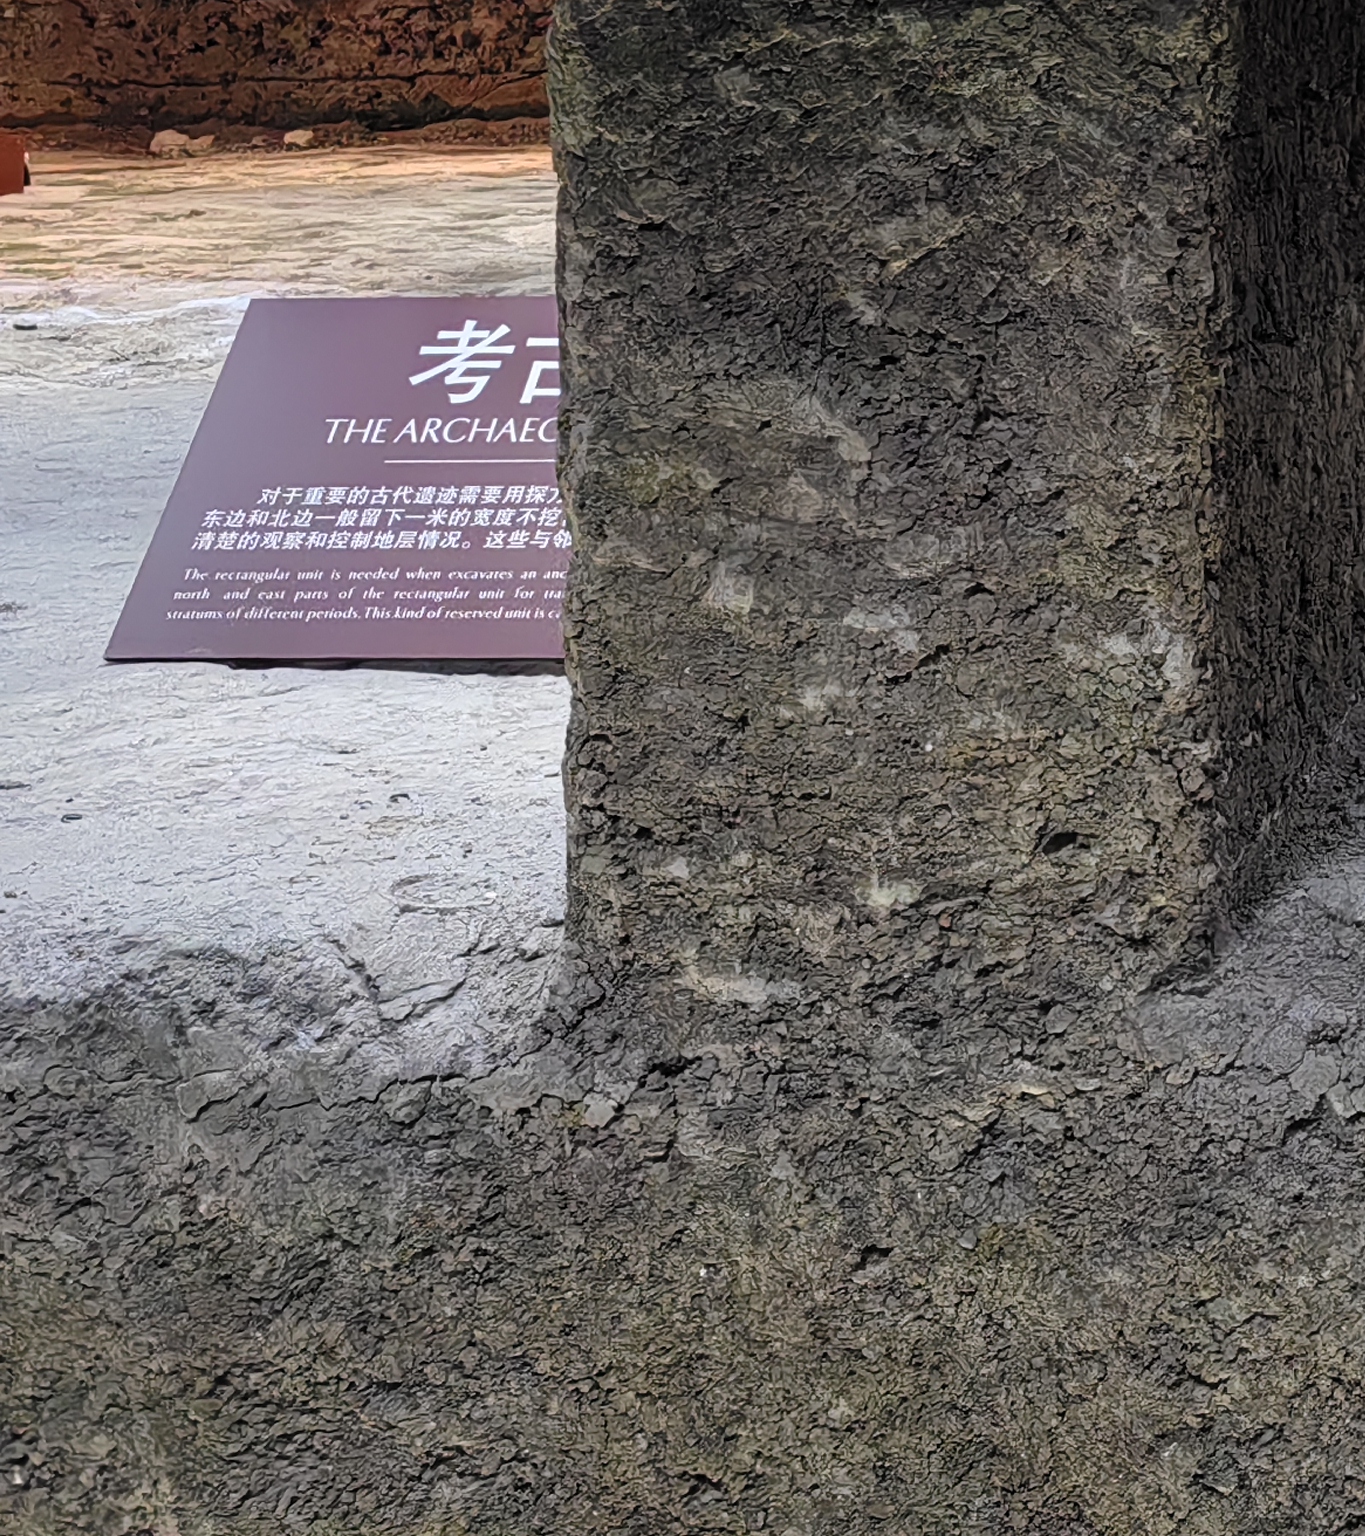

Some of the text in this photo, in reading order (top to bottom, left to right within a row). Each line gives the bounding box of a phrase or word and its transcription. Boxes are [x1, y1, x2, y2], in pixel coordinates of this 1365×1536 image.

[325, 418, 392, 444] THE
[184, 568, 207, 580] The
[214, 568, 290, 583] rectangular
[297, 569, 323, 580] unit
[330, 569, 341, 580] is
[349, 567, 399, 580] needed
[406, 567, 441, 580] when
[448, 569, 513, 580] excavates
[520, 570, 537, 580] an
[173, 588, 210, 600] north
[223, 588, 250, 600] and
[258, 590, 285, 600] east
[294, 590, 329, 603] parts
[338, 586, 357, 600] of
[363, 587, 384, 599] the
[393, 586, 470, 602] rectangular
[479, 588, 504, 599] unit
[513, 585, 535, 599] for
[166, 609, 223, 620] stratums
[226, 607, 243, 620] of
[244, 606, 303, 620] different
[364, 606, 390, 619] This
[427, 606, 446, 619] of
[445, 606, 501, 619] reserved
[505, 607, 531, 619] unit
[534, 607, 545, 619] is
